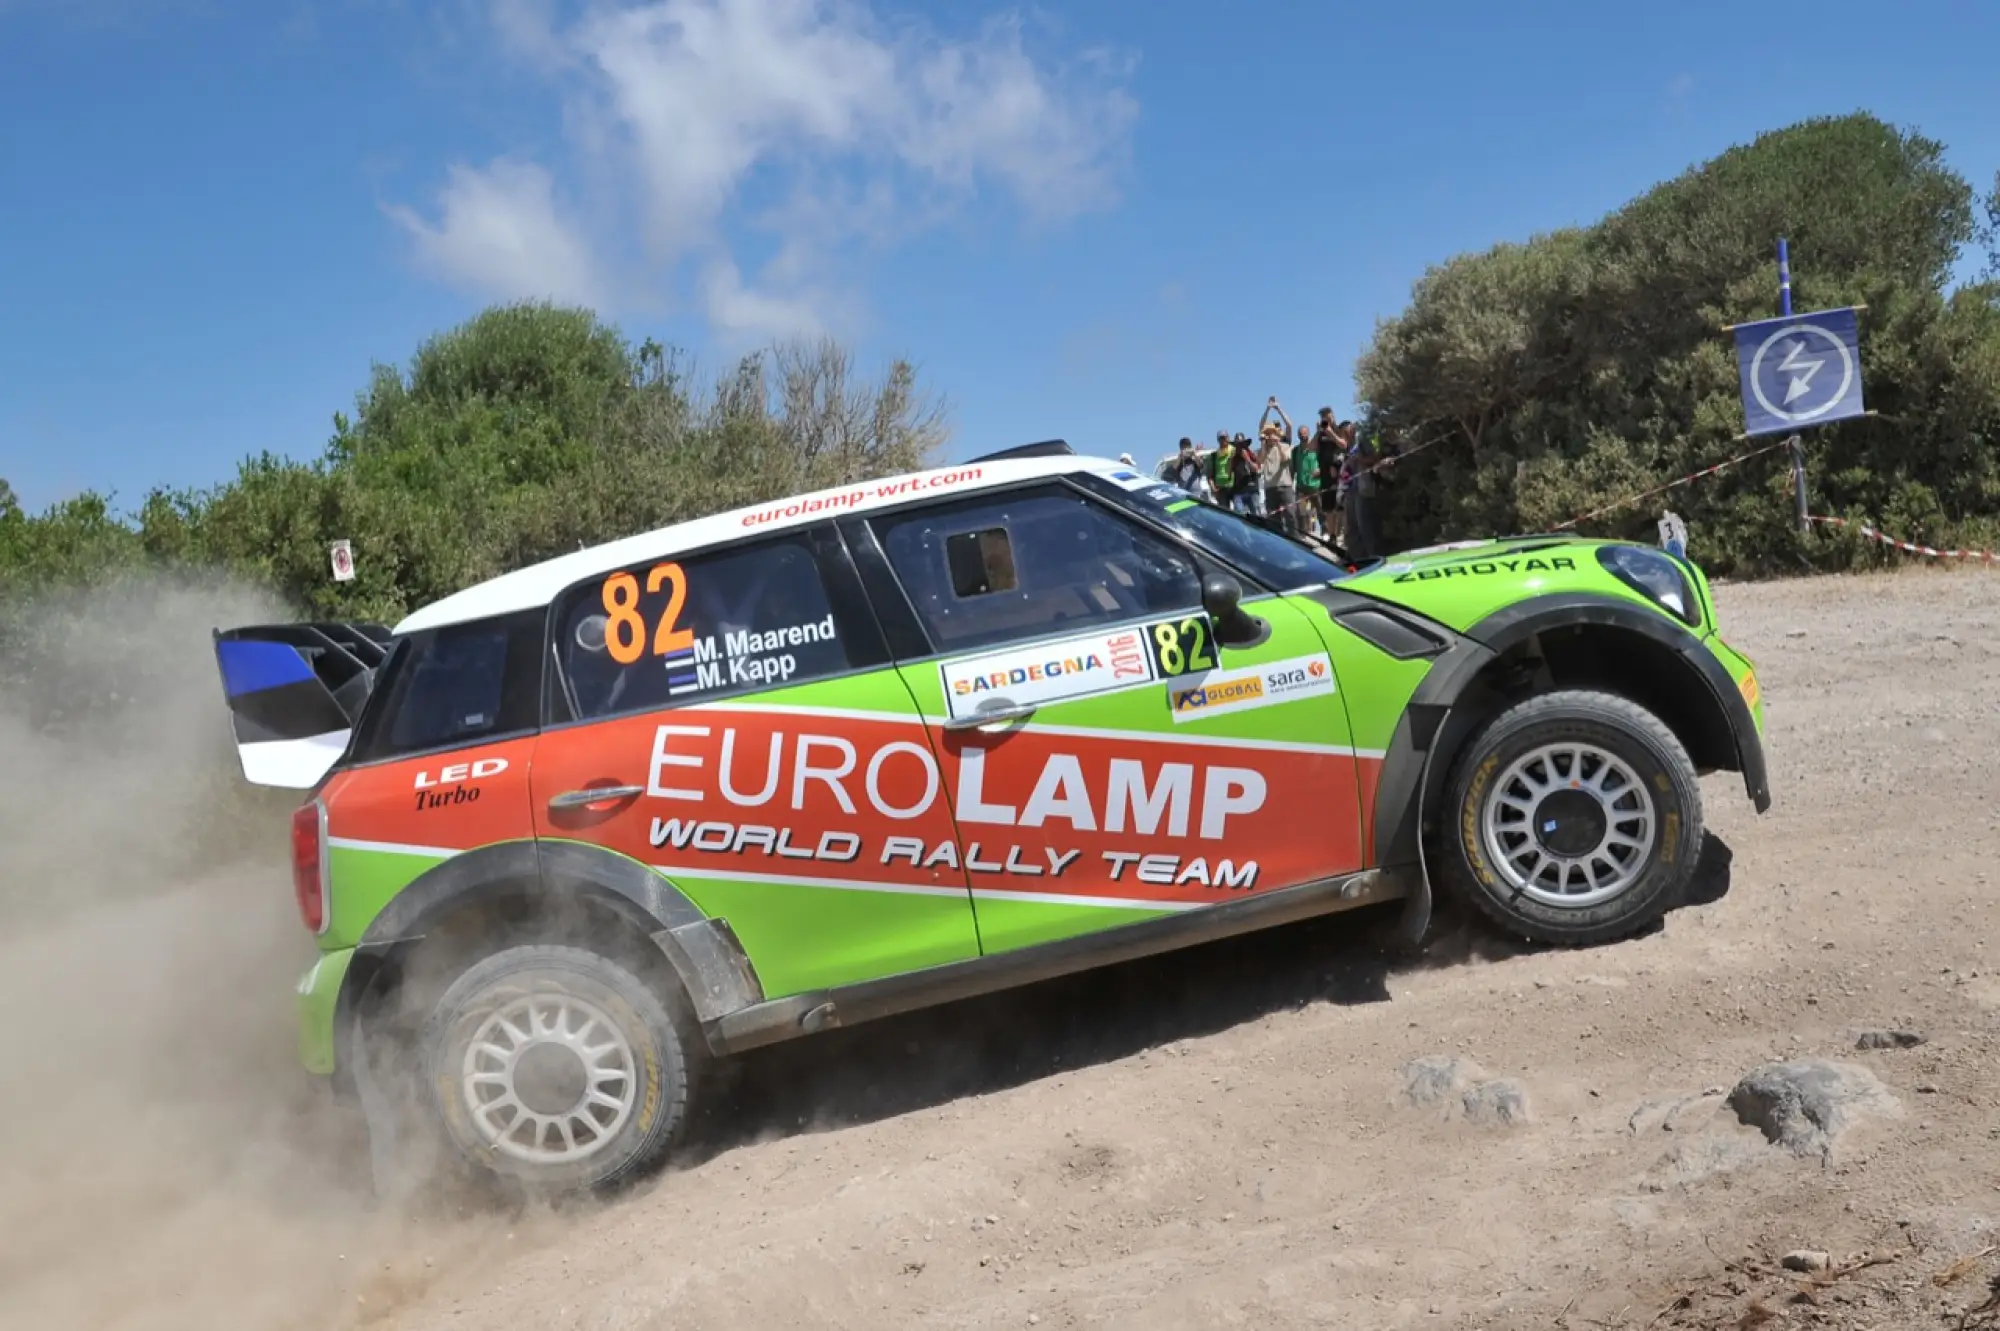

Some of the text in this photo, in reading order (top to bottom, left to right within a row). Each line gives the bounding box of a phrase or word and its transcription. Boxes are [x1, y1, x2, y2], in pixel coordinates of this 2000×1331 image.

[741, 467, 982, 528] eurolamp-wrt.com
[1393, 557, 1576, 583] ZBROYAR
[602, 561, 693, 664] 82
[727, 615, 836, 658] Maarend
[1107, 634, 1145, 679] 2016
[1155, 618, 1213, 676] 82
[730, 656, 796, 684] Kapp
[953, 653, 1104, 696] SARDEGNA
[1208, 682, 1262, 701] GLOBAL
[1267, 667, 1306, 688] sara
[414, 759, 508, 789] LED
[646, 724, 1267, 839] EUROLAMP
[415, 785, 480, 811] Turbo
[649, 816, 1260, 890] WORLD RALLY TEAM
